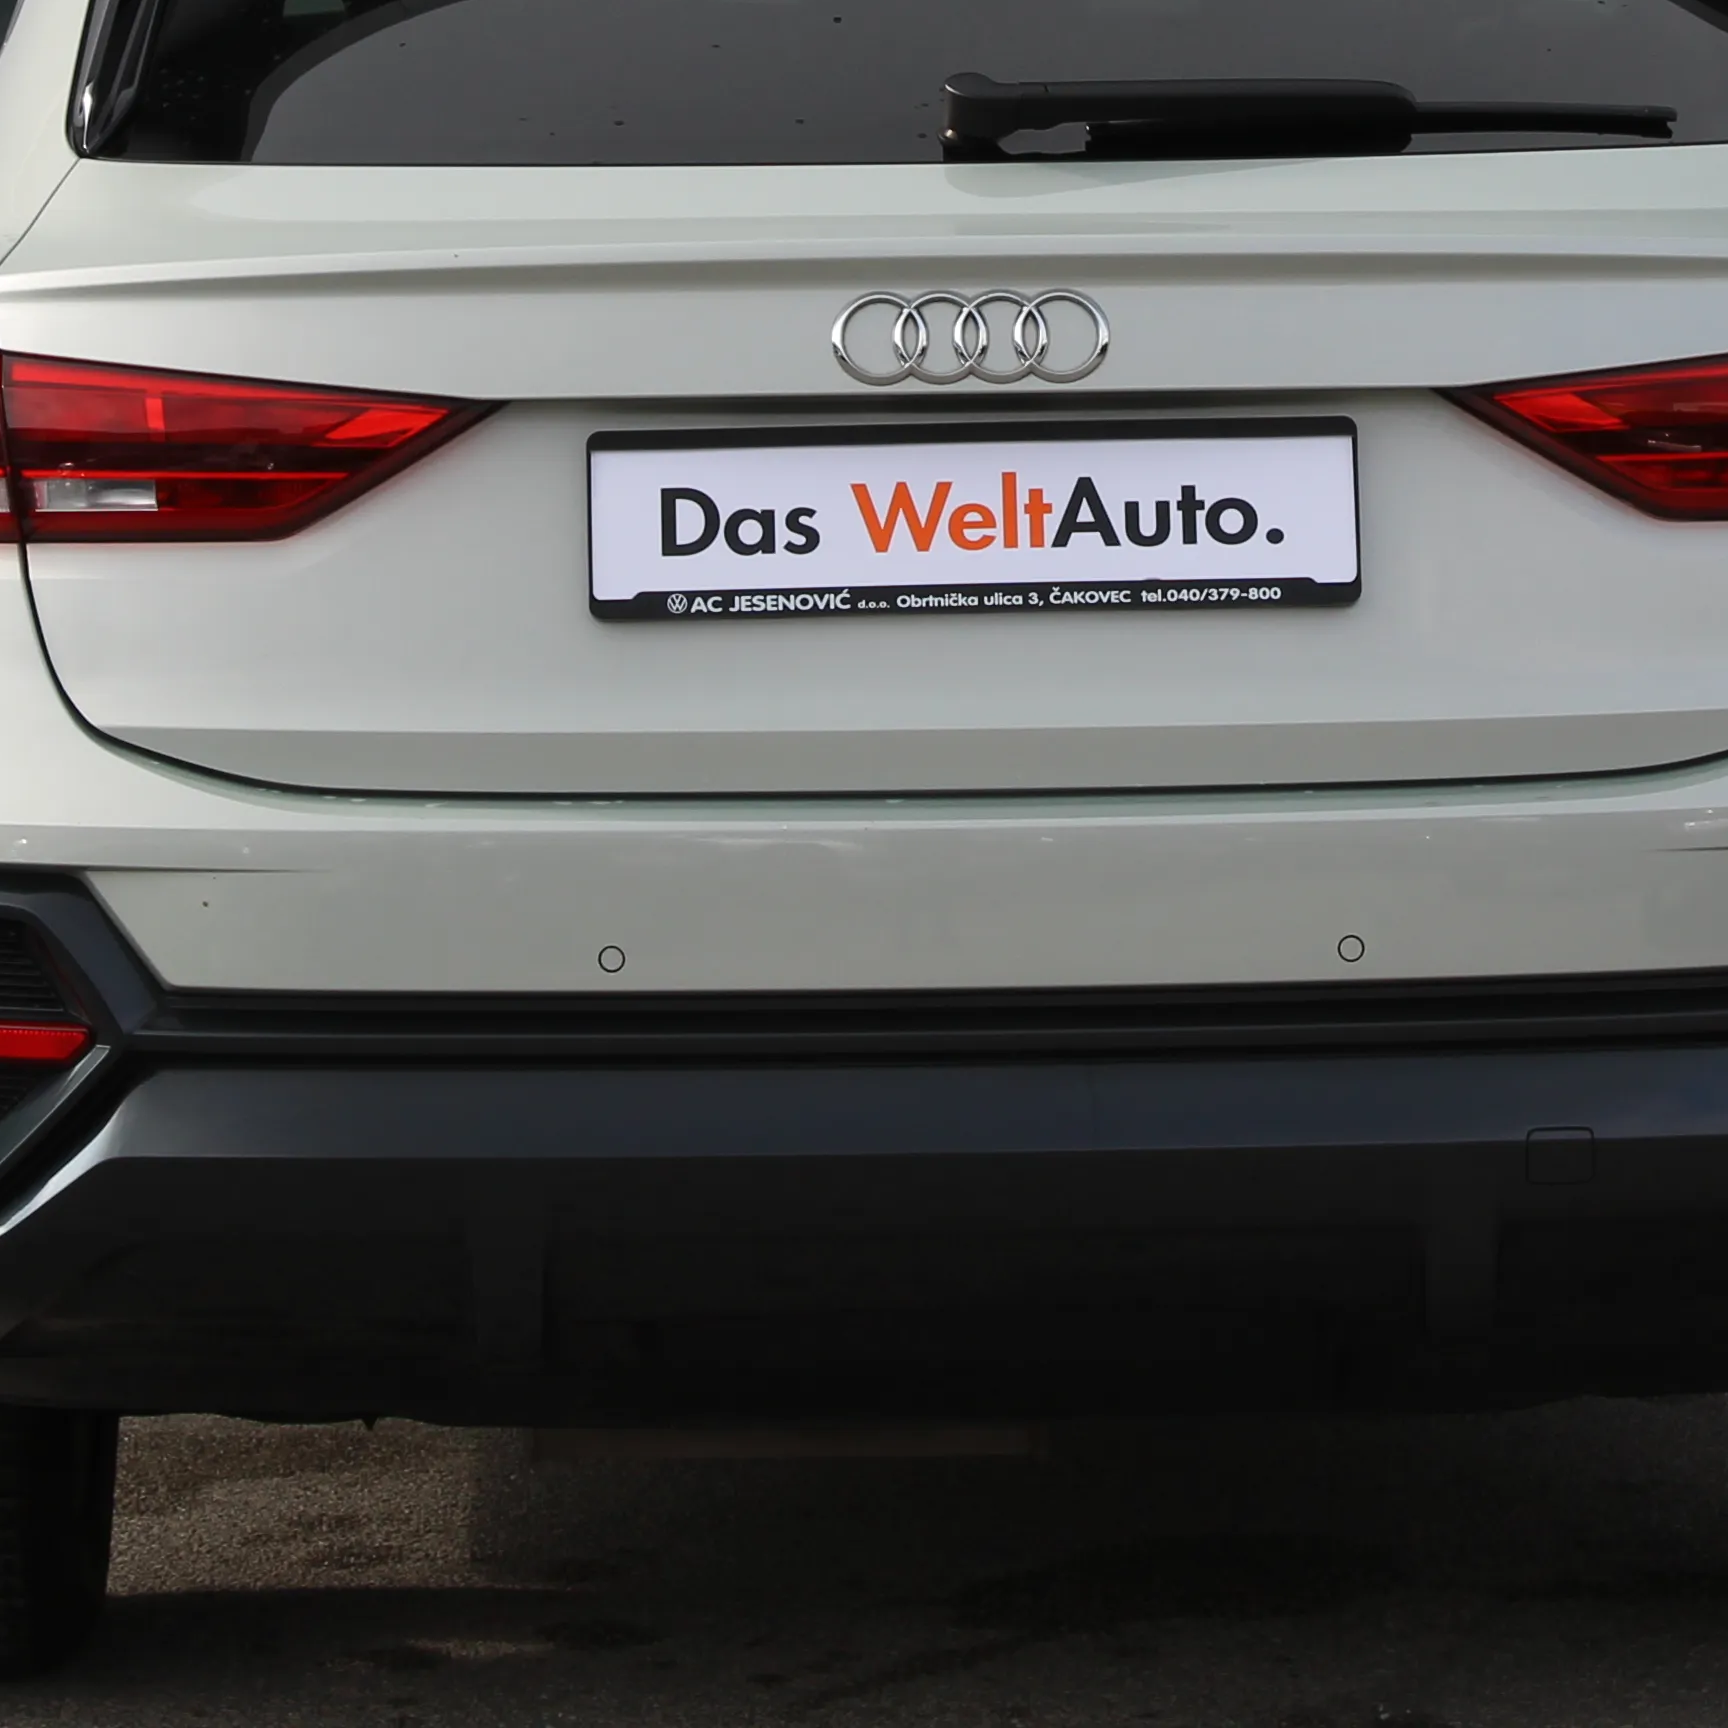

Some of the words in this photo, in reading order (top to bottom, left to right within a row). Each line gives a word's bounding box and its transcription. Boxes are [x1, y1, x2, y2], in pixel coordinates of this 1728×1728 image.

[659, 486, 822, 558] Das
[849, 470, 1286, 554] WeltAuto.
[690, 595, 723, 614] AC
[728, 587, 852, 613] JESENOVIĆ
[857, 598, 891, 610] d.o.o.
[896, 591, 980, 608] Obrtnička
[982, 591, 1024, 607] ulica
[1028, 590, 1045, 607] 3,
[1048, 585, 1132, 605] ČAKOVEC
[1140, 585, 1283, 604] tel.040/379-800
